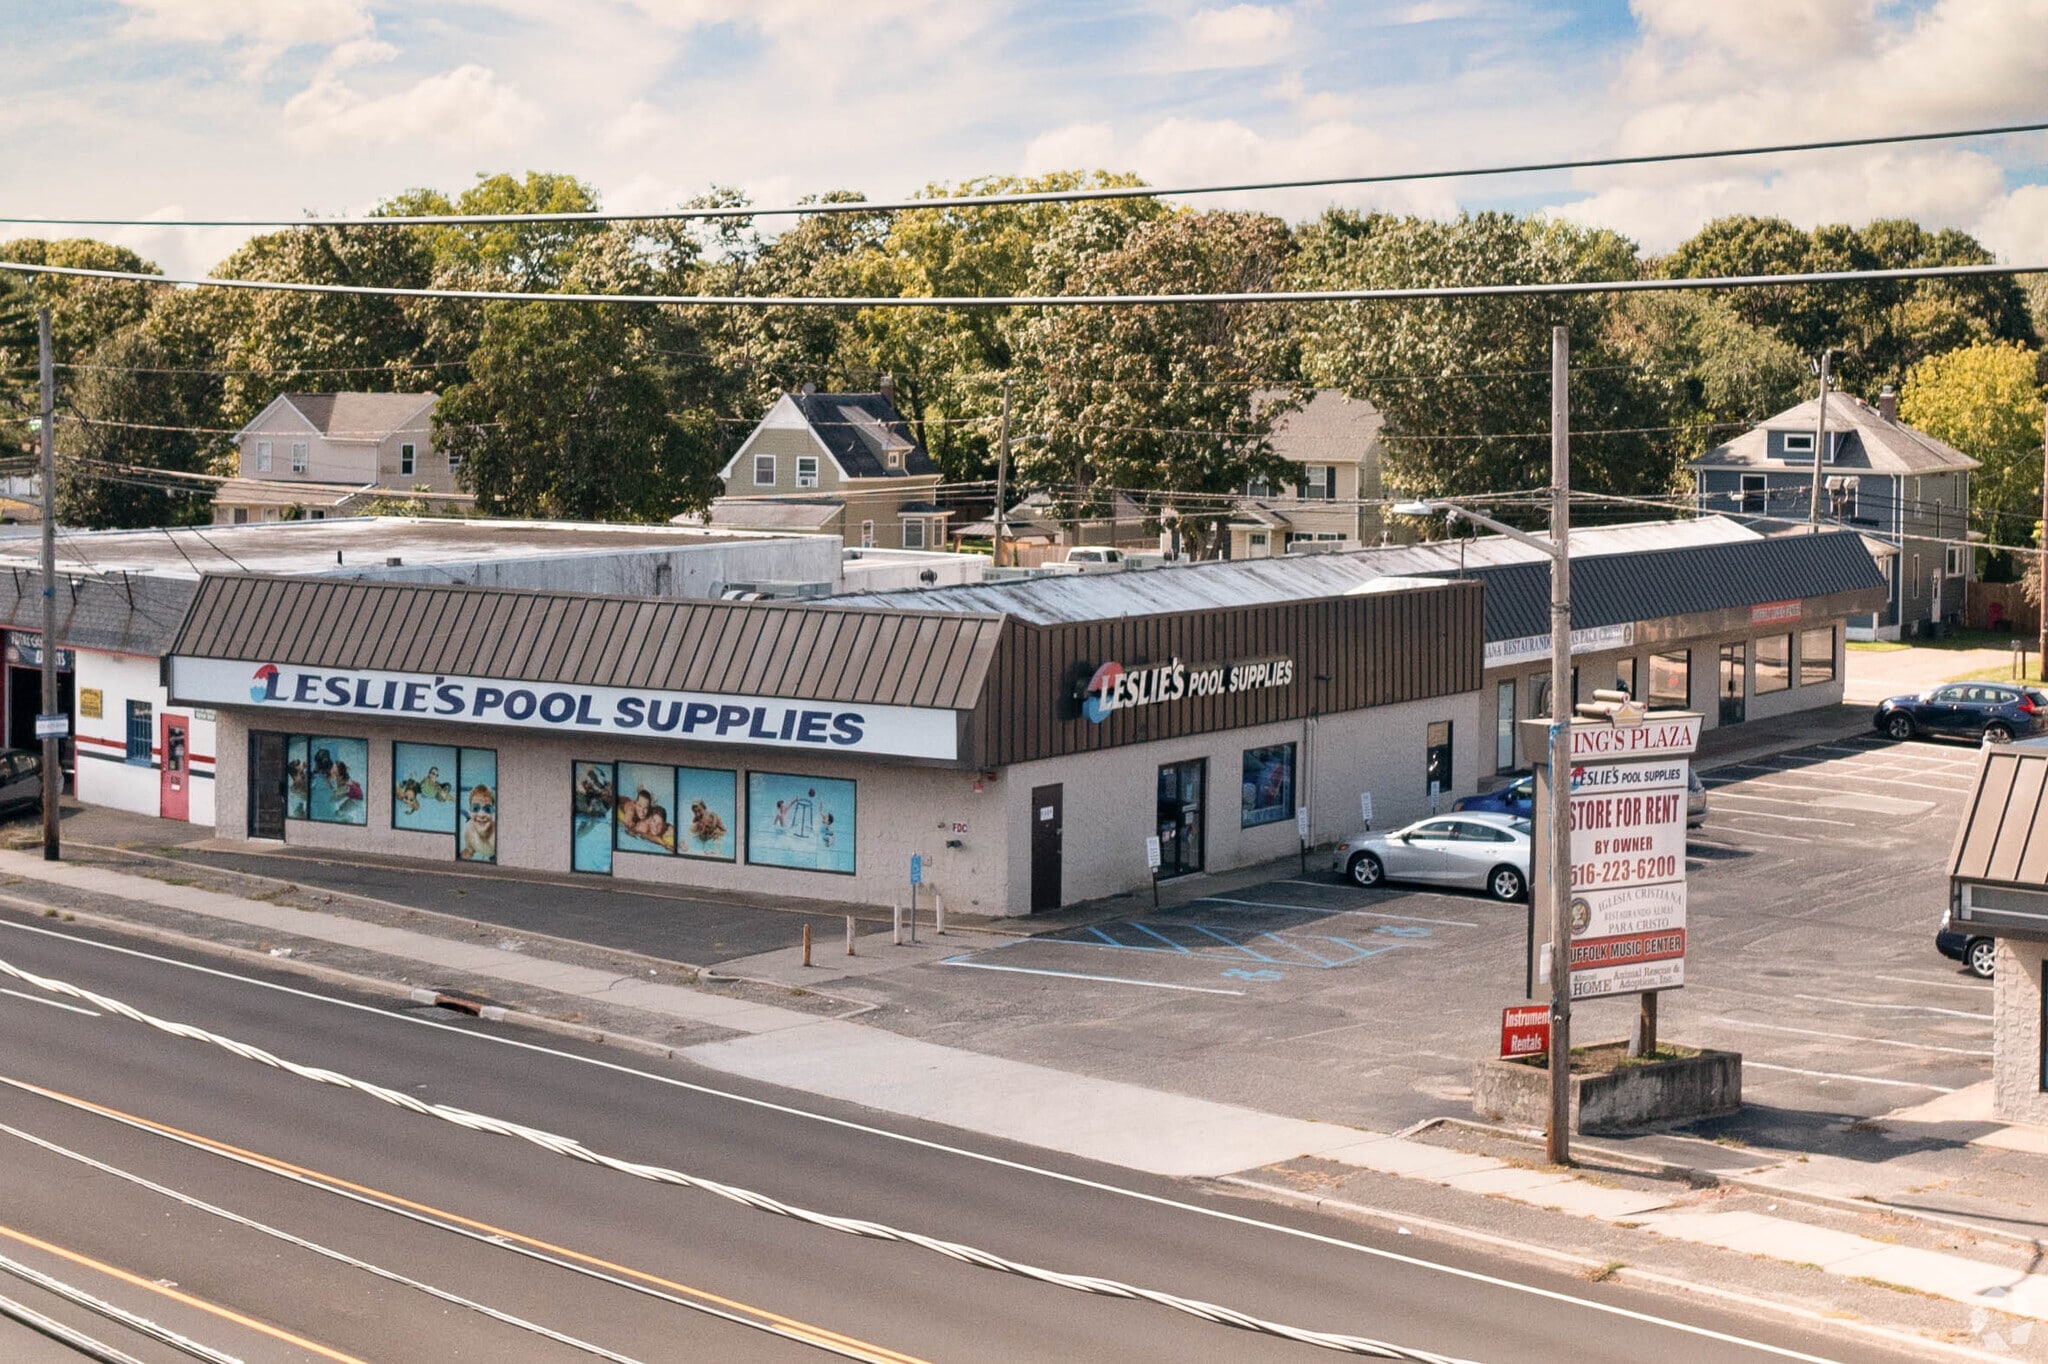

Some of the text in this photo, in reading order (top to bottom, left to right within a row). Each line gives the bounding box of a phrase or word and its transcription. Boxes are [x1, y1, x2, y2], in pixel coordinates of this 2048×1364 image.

[1099, 657, 1293, 712] LESLIE'S POOL SUPPLIES
[264, 672, 865, 745] LESLIE'S POOL SUPPLIES
[1573, 725, 1693, 754] ING'S PLAZA
[1572, 766, 1680, 787] LESLIE'S POOL SUPPLIES
[1571, 794, 1680, 832] STORE FOR RENT
[952, 822, 968, 833] FDC
[1595, 836, 1653, 855] BY OWNER
[1571, 855, 1676, 886] 516-223-6200
[1598, 888, 1682, 912] IGLESIA CRISTIANA
[1608, 917, 1670, 934] PARA CRISTO
[1570, 936, 1681, 963] UFFOLK MUSIC CENTER
[1573, 979, 1612, 996] HOME
[1505, 1009, 1550, 1028] Instrumen
[1511, 1033, 1542, 1053] Rentals
